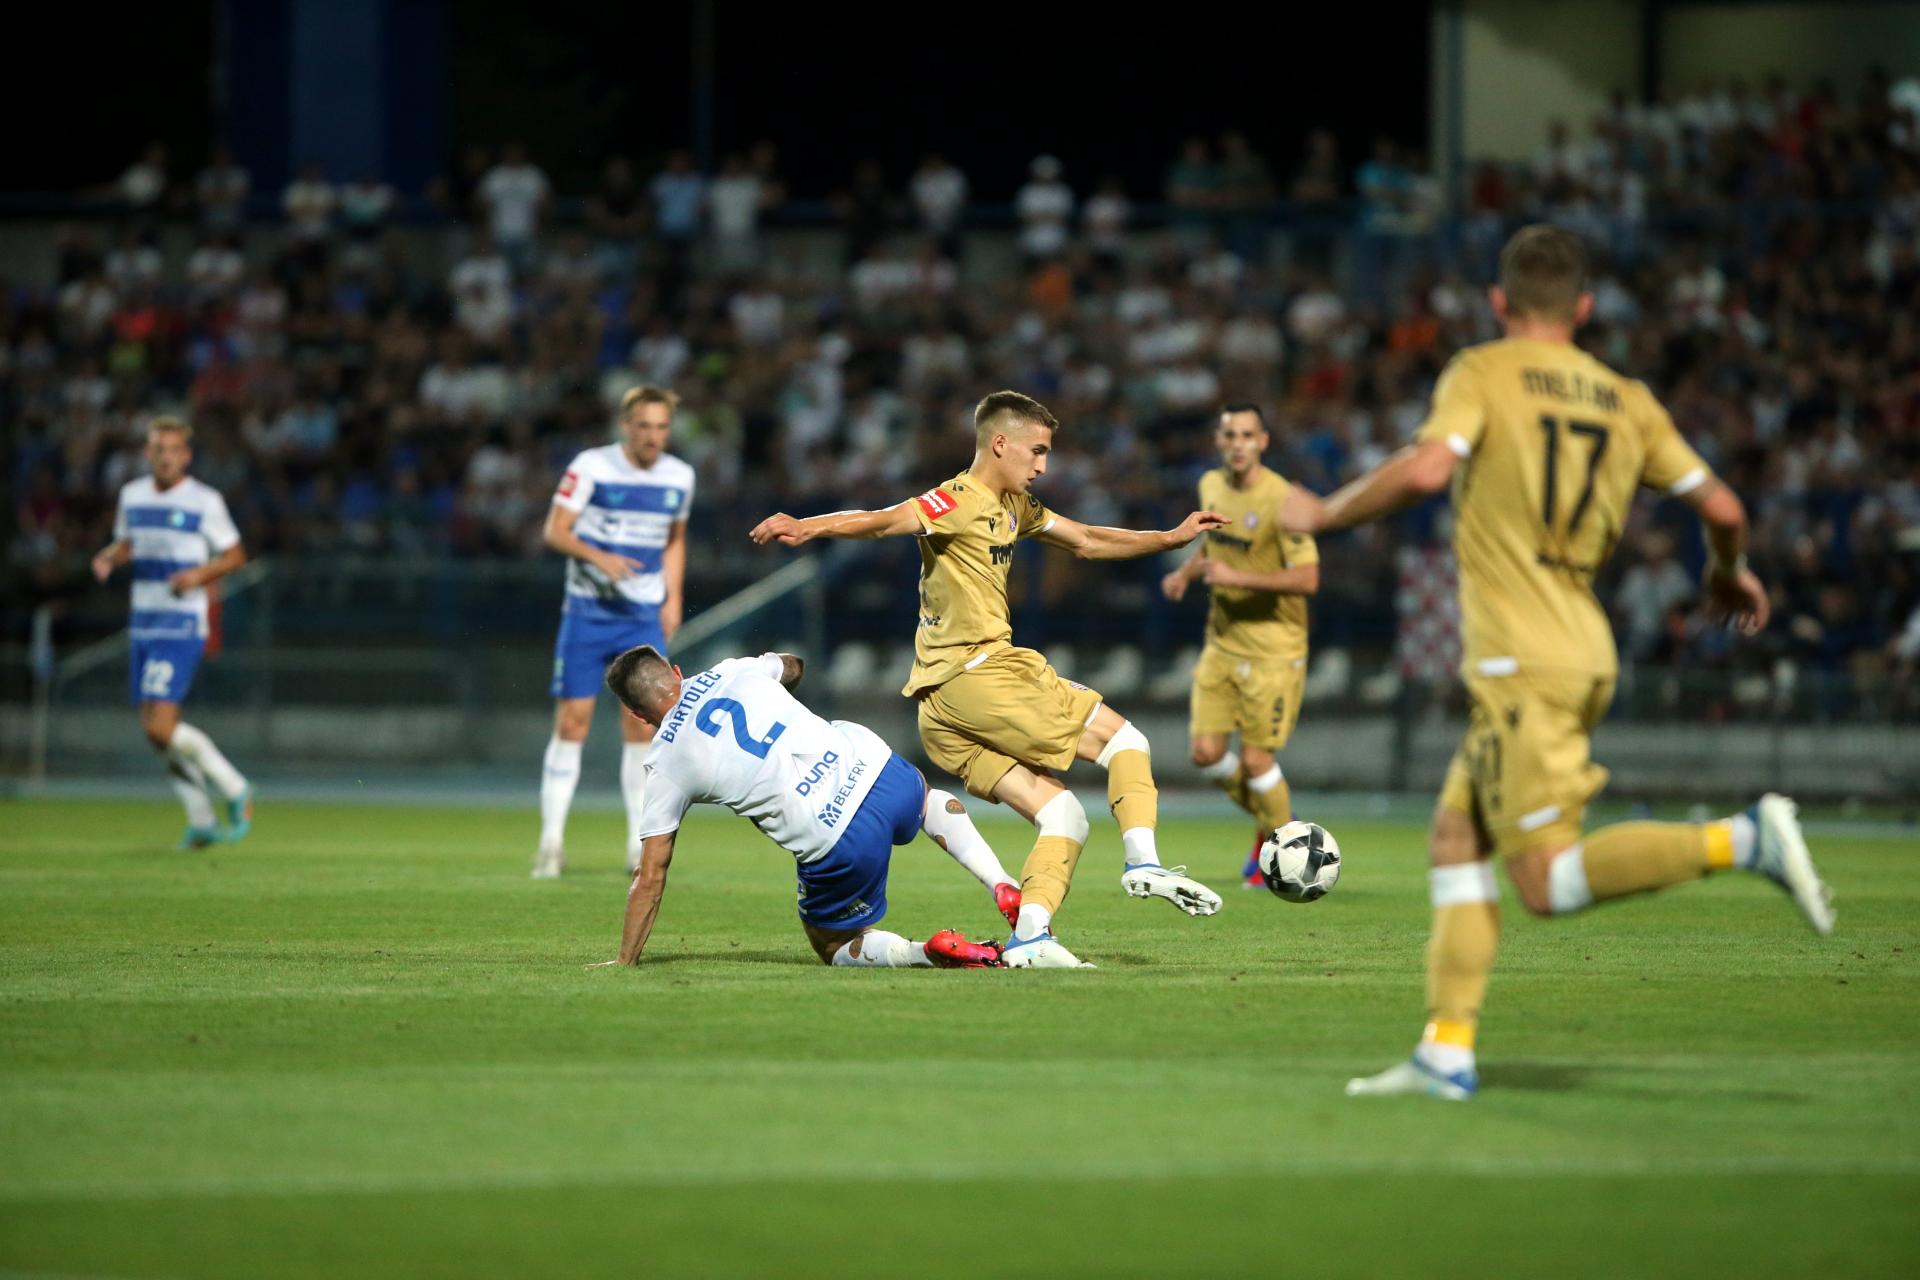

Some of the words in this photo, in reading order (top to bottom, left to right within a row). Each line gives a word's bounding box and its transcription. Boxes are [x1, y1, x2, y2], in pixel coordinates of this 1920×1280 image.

[1541, 415, 1610, 534] 17
[660, 670, 722, 743] BARTOLEC
[696, 697, 786, 760] 2
[833, 759, 867, 806] BELFRY
